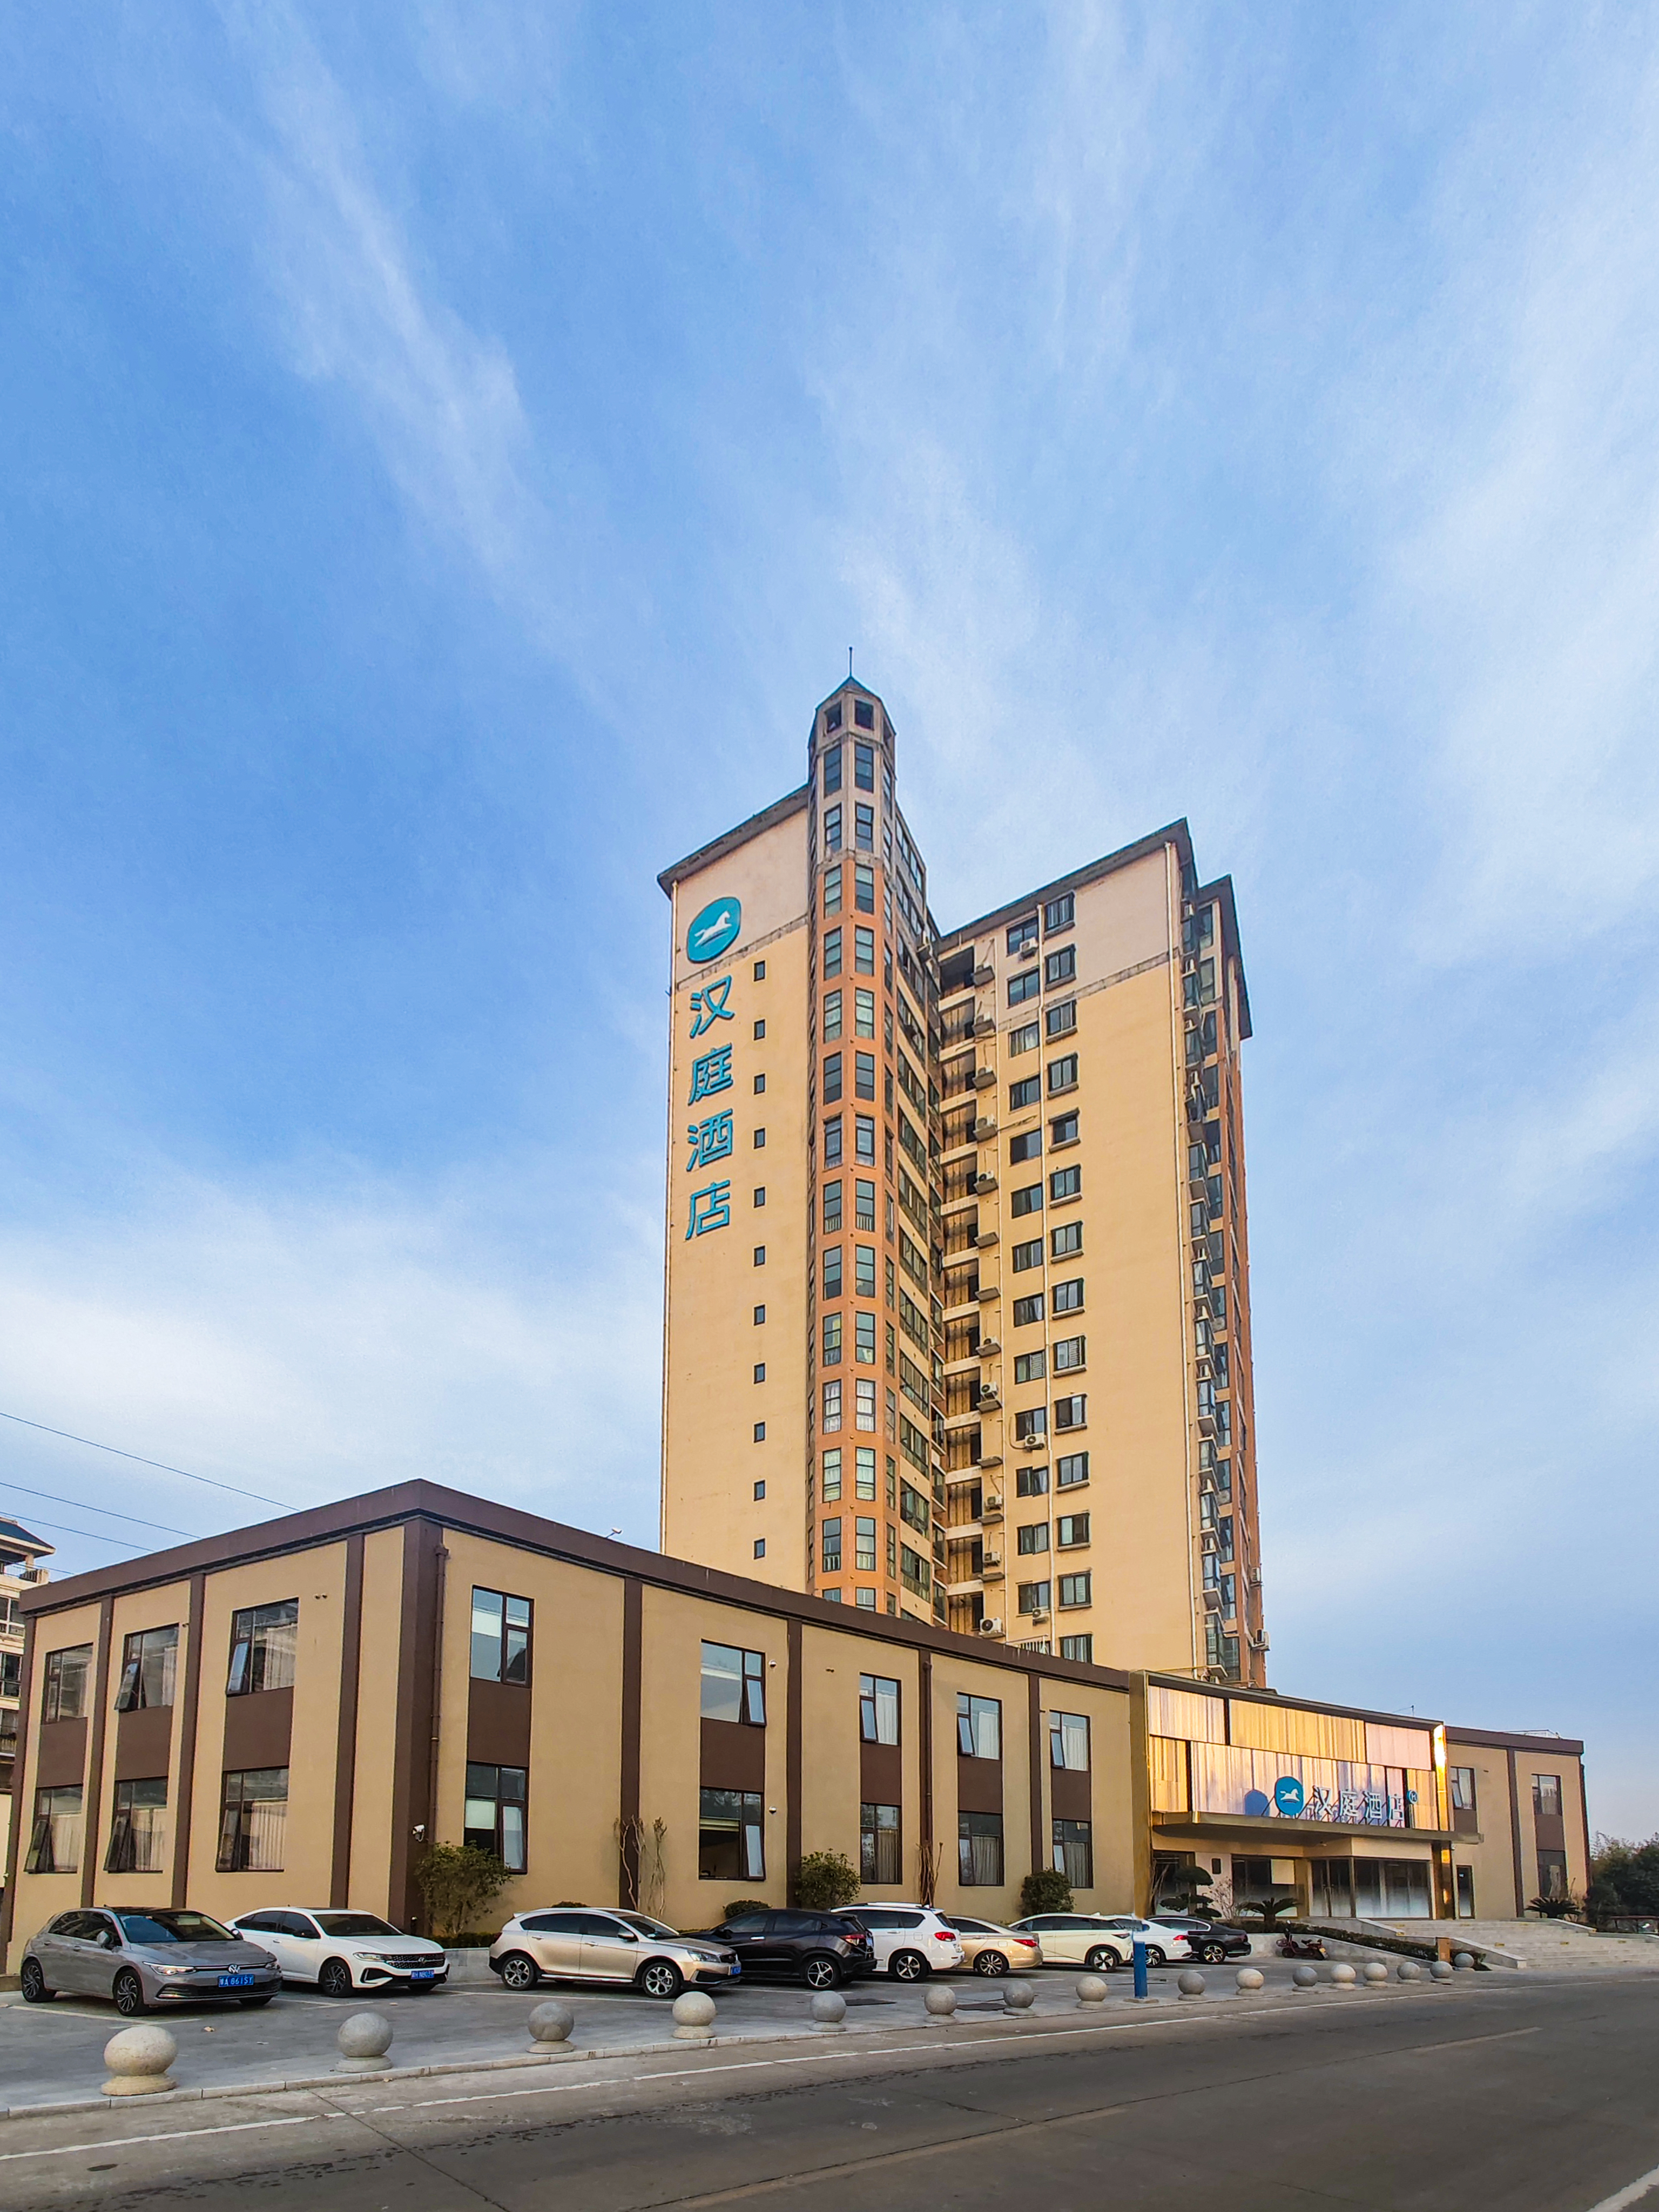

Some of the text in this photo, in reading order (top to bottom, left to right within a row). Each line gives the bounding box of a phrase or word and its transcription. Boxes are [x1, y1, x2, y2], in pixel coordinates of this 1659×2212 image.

[685, 975, 735, 1241] 汉庭酒店
[1313, 1785, 1404, 1821] 汉庭酒店
